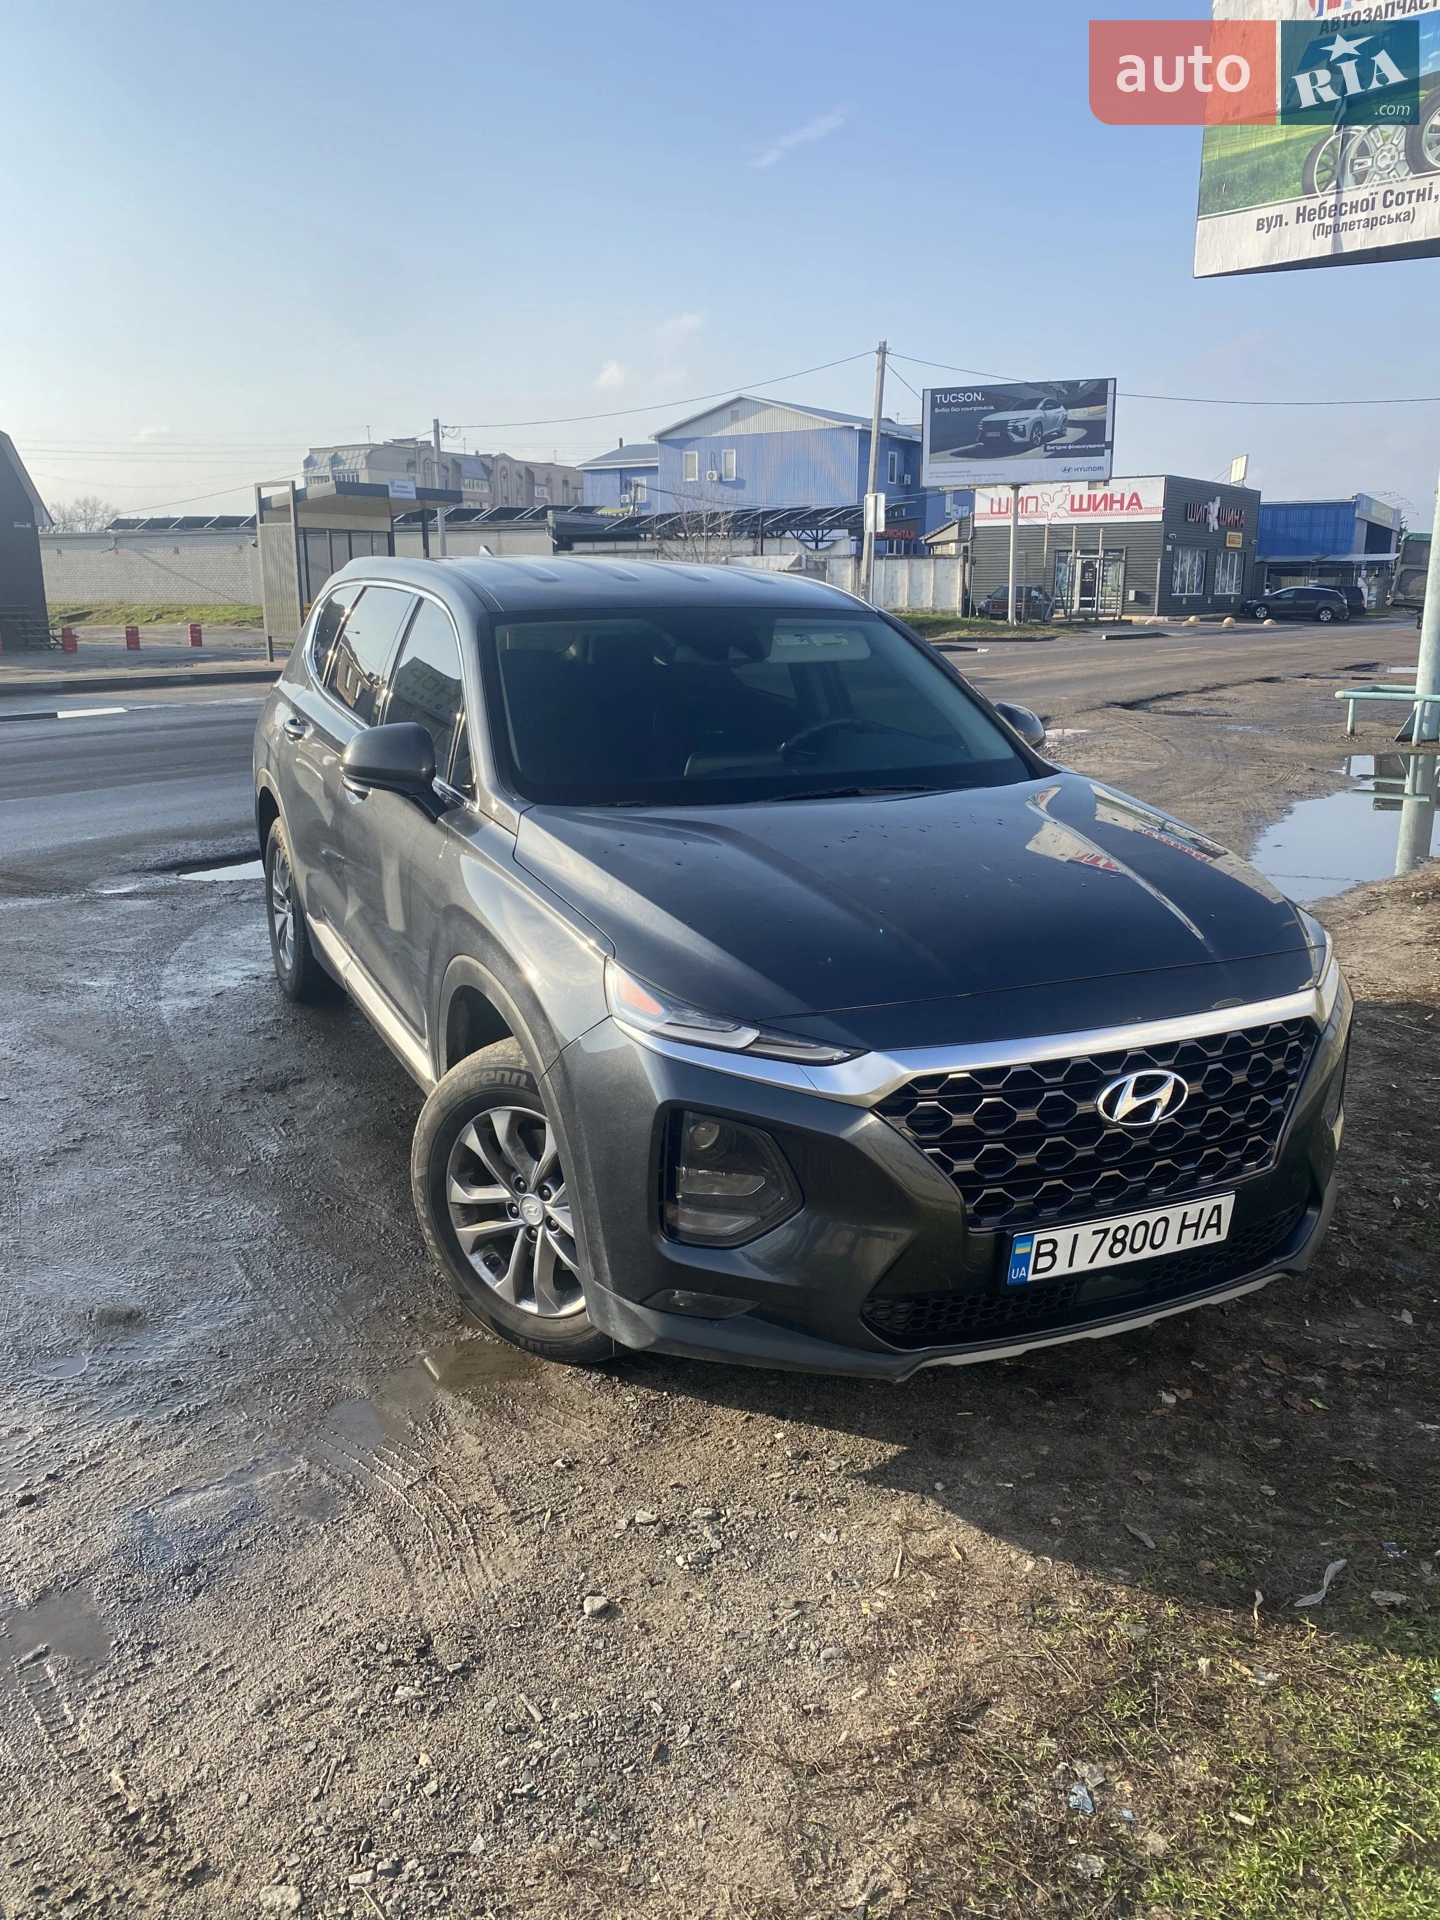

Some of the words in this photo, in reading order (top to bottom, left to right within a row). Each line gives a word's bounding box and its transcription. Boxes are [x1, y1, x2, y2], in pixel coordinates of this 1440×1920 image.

[1256, 213, 1289, 233] вул.
[1295, 191, 1378, 224] Небесної
[1382, 182, 1439, 208] Сотні,
[1312, 207, 1416, 240] (Пролетарська)
[935, 392, 985, 404] TUCSON.
[990, 496, 1039, 514] ШИП
[1070, 492, 1143, 512] ШИНА
[1187, 502, 1209, 524] ШИП
[1219, 507, 1245, 528] ШИНА
[1011, 1266, 1027, 1279] UA
